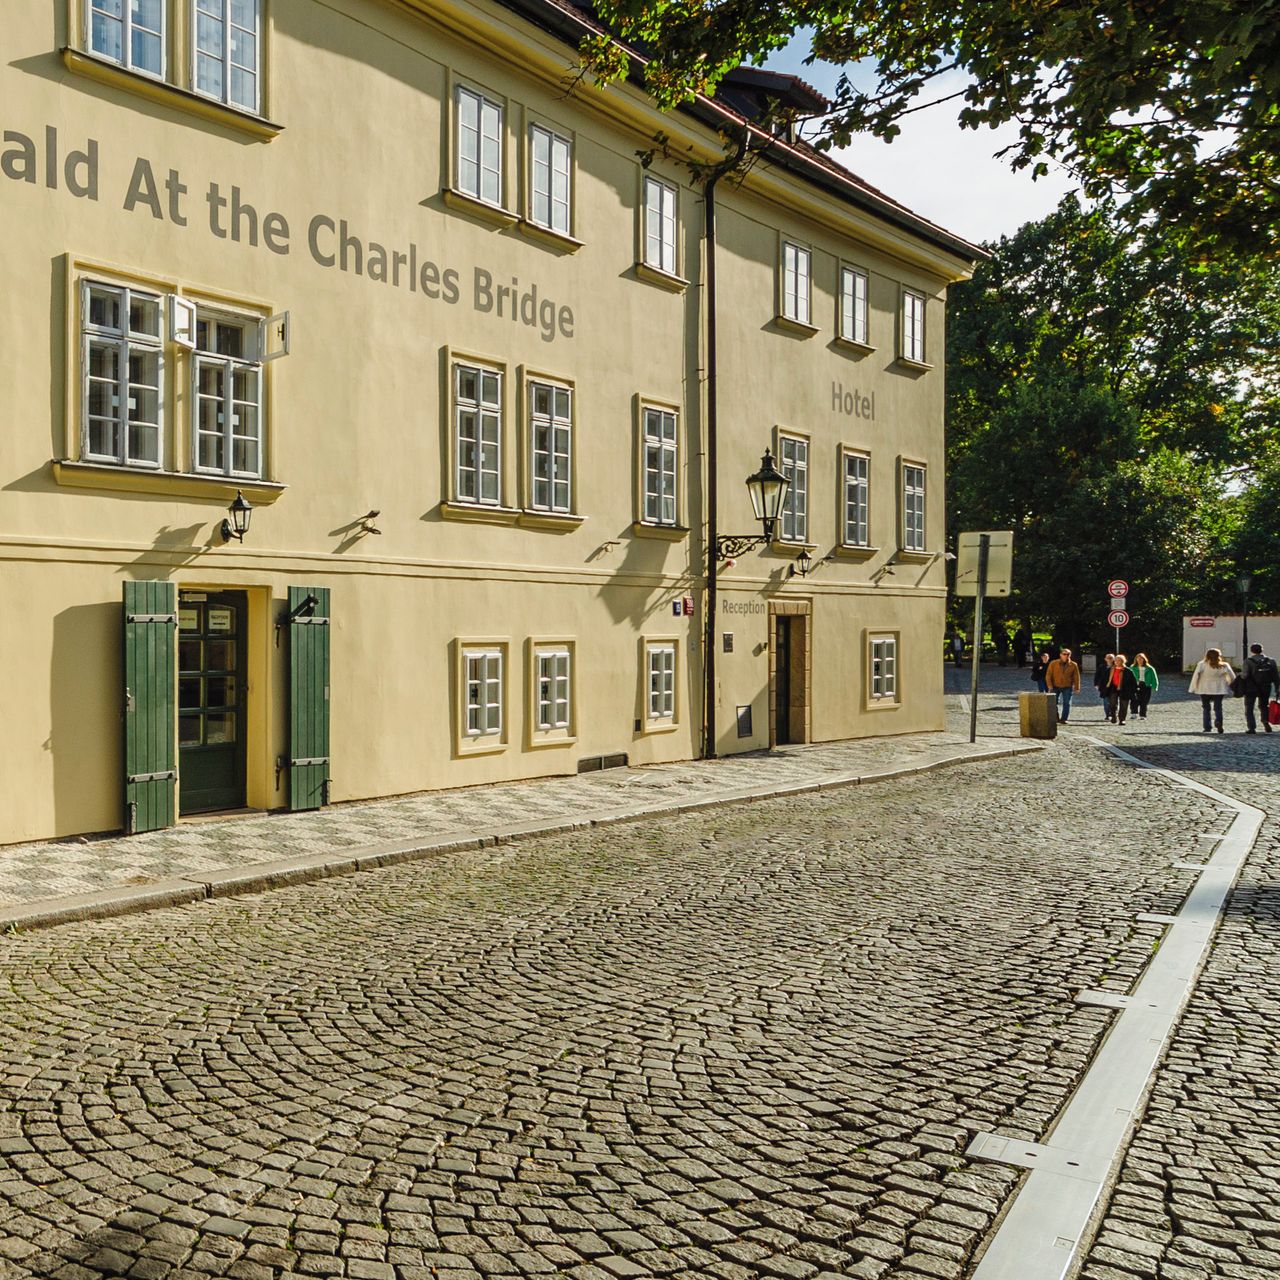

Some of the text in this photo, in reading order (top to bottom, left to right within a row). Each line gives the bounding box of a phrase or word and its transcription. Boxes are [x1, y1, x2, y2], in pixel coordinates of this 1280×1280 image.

[123, 157, 188, 227] At
[206, 182, 290, 255] the
[308, 214, 460, 305] Charles
[473, 266, 574, 342] Bridge
[831, 381, 875, 421] Hotel
[722, 599, 766, 618] Reception
[1114, 614, 1124, 623] 10
